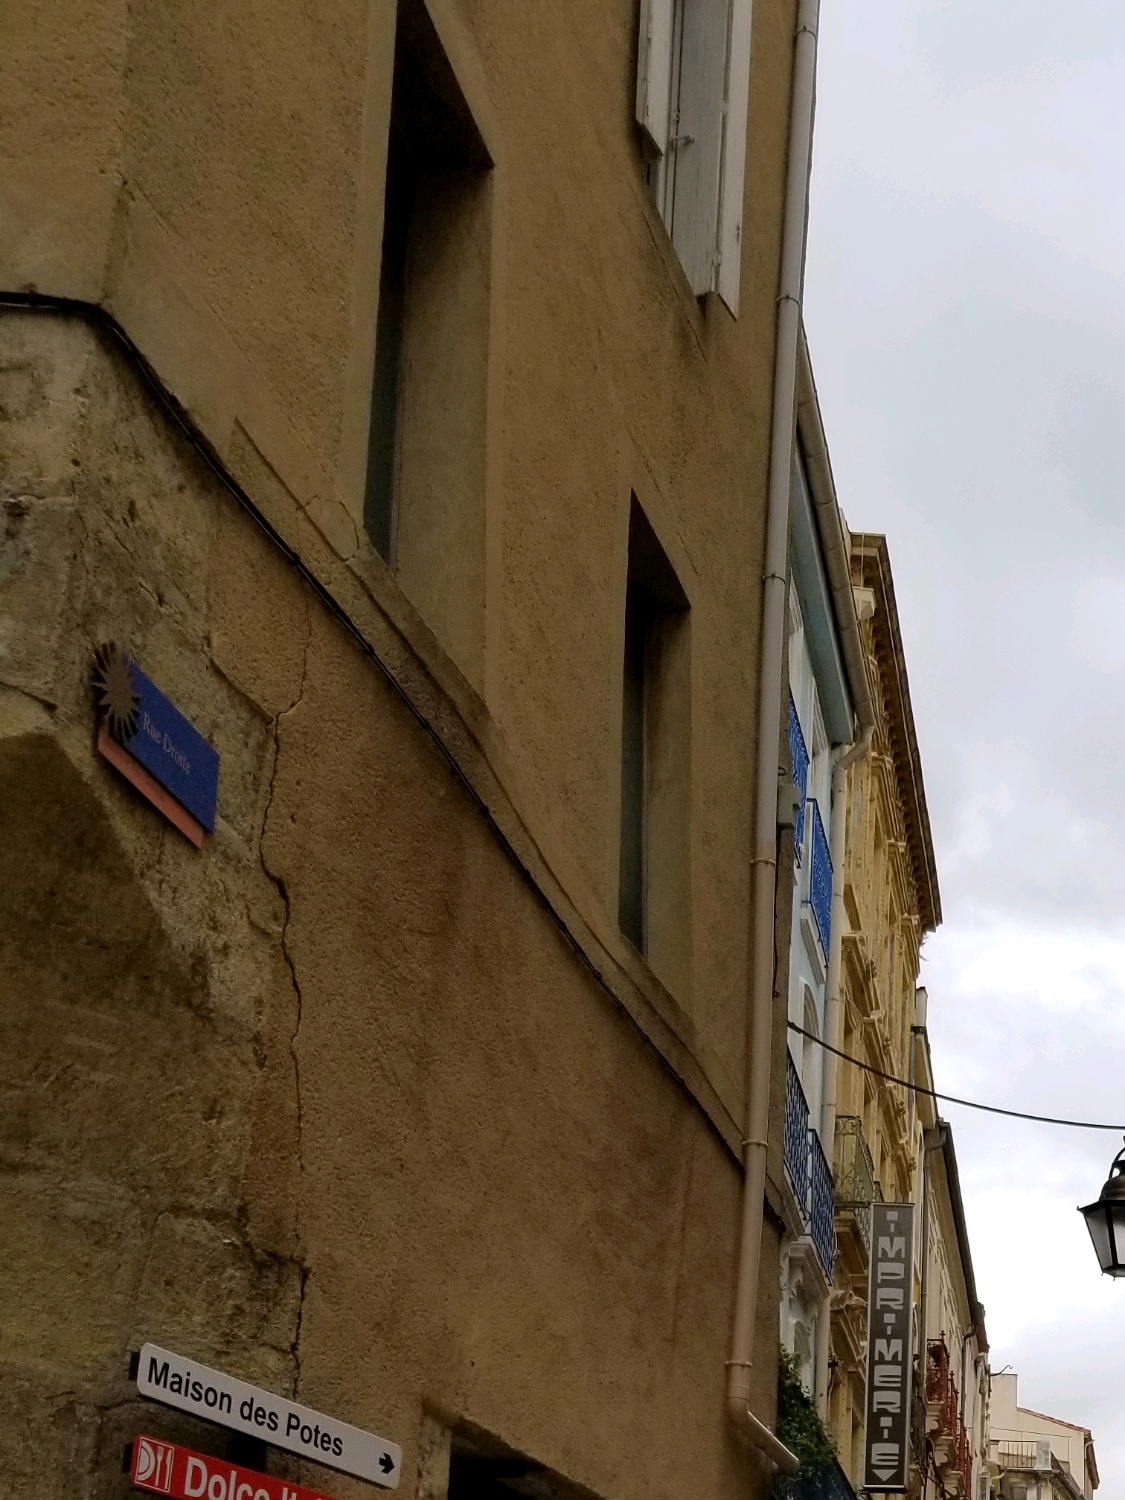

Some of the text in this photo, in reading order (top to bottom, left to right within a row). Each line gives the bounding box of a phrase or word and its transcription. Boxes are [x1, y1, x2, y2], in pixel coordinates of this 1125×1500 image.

[142, 711, 161, 745] Rue
[147, 1356, 344, 1457] Maison des Potes
